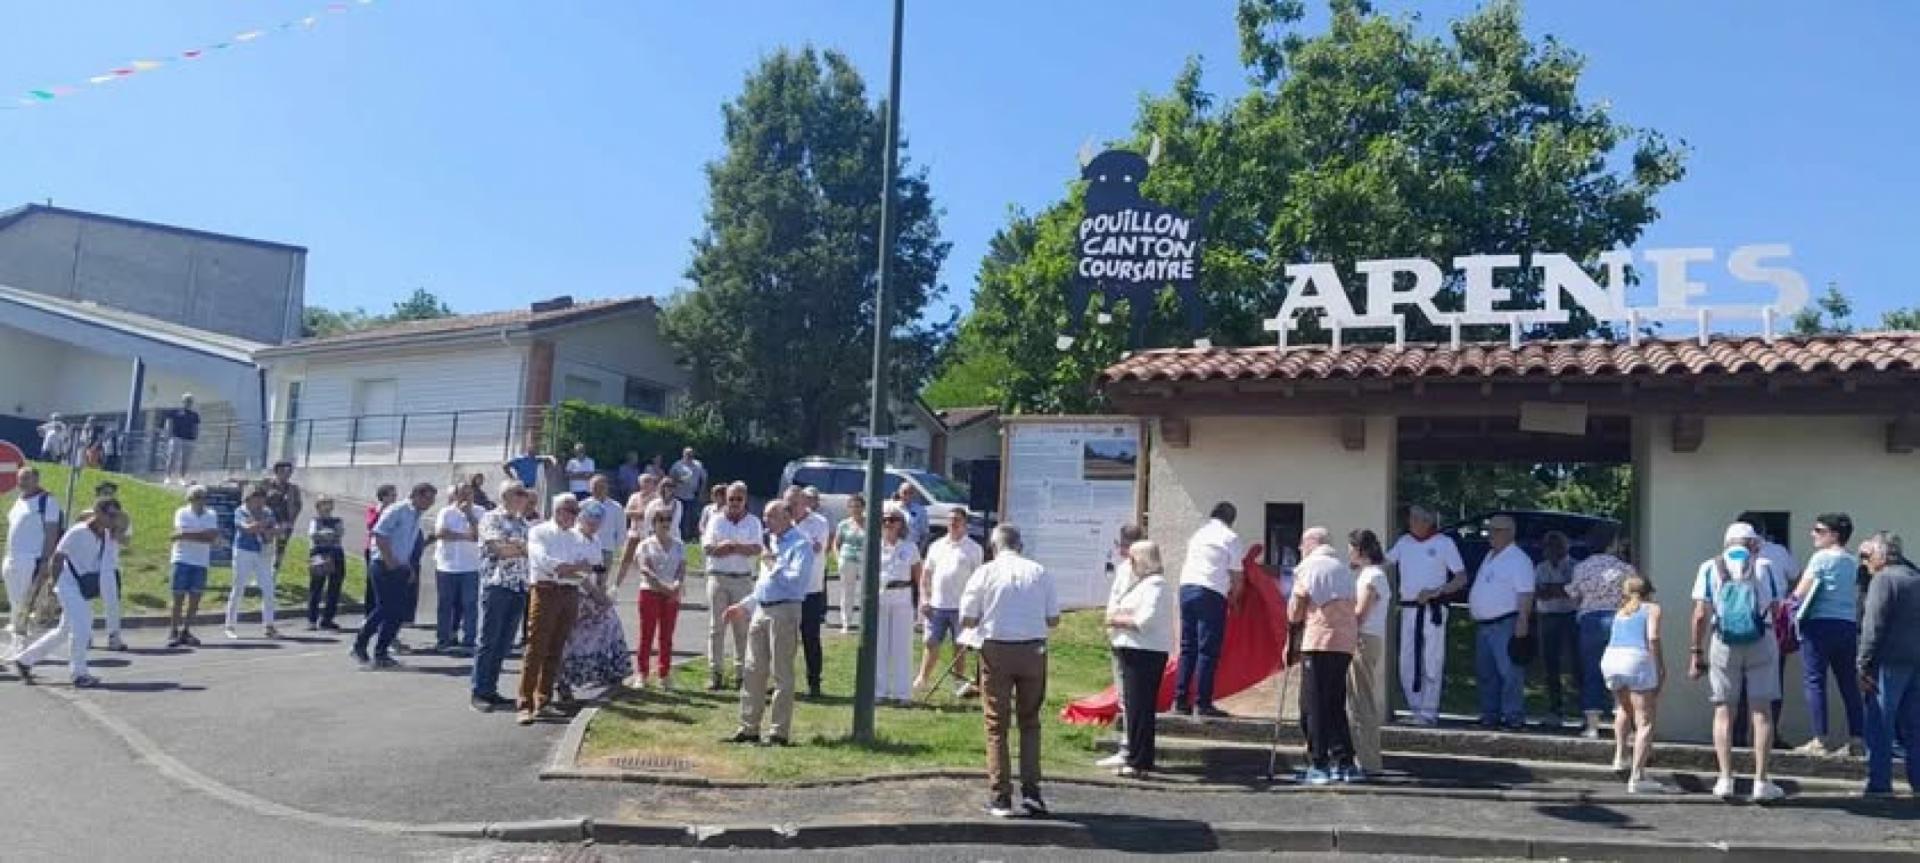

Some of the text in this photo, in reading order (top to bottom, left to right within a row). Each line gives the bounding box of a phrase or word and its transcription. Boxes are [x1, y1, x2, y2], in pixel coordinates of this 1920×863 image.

[1083, 236, 1196, 258] CANTON
[1079, 257, 1194, 282] COURSAYRE
[1263, 243, 1810, 331] ARENES
